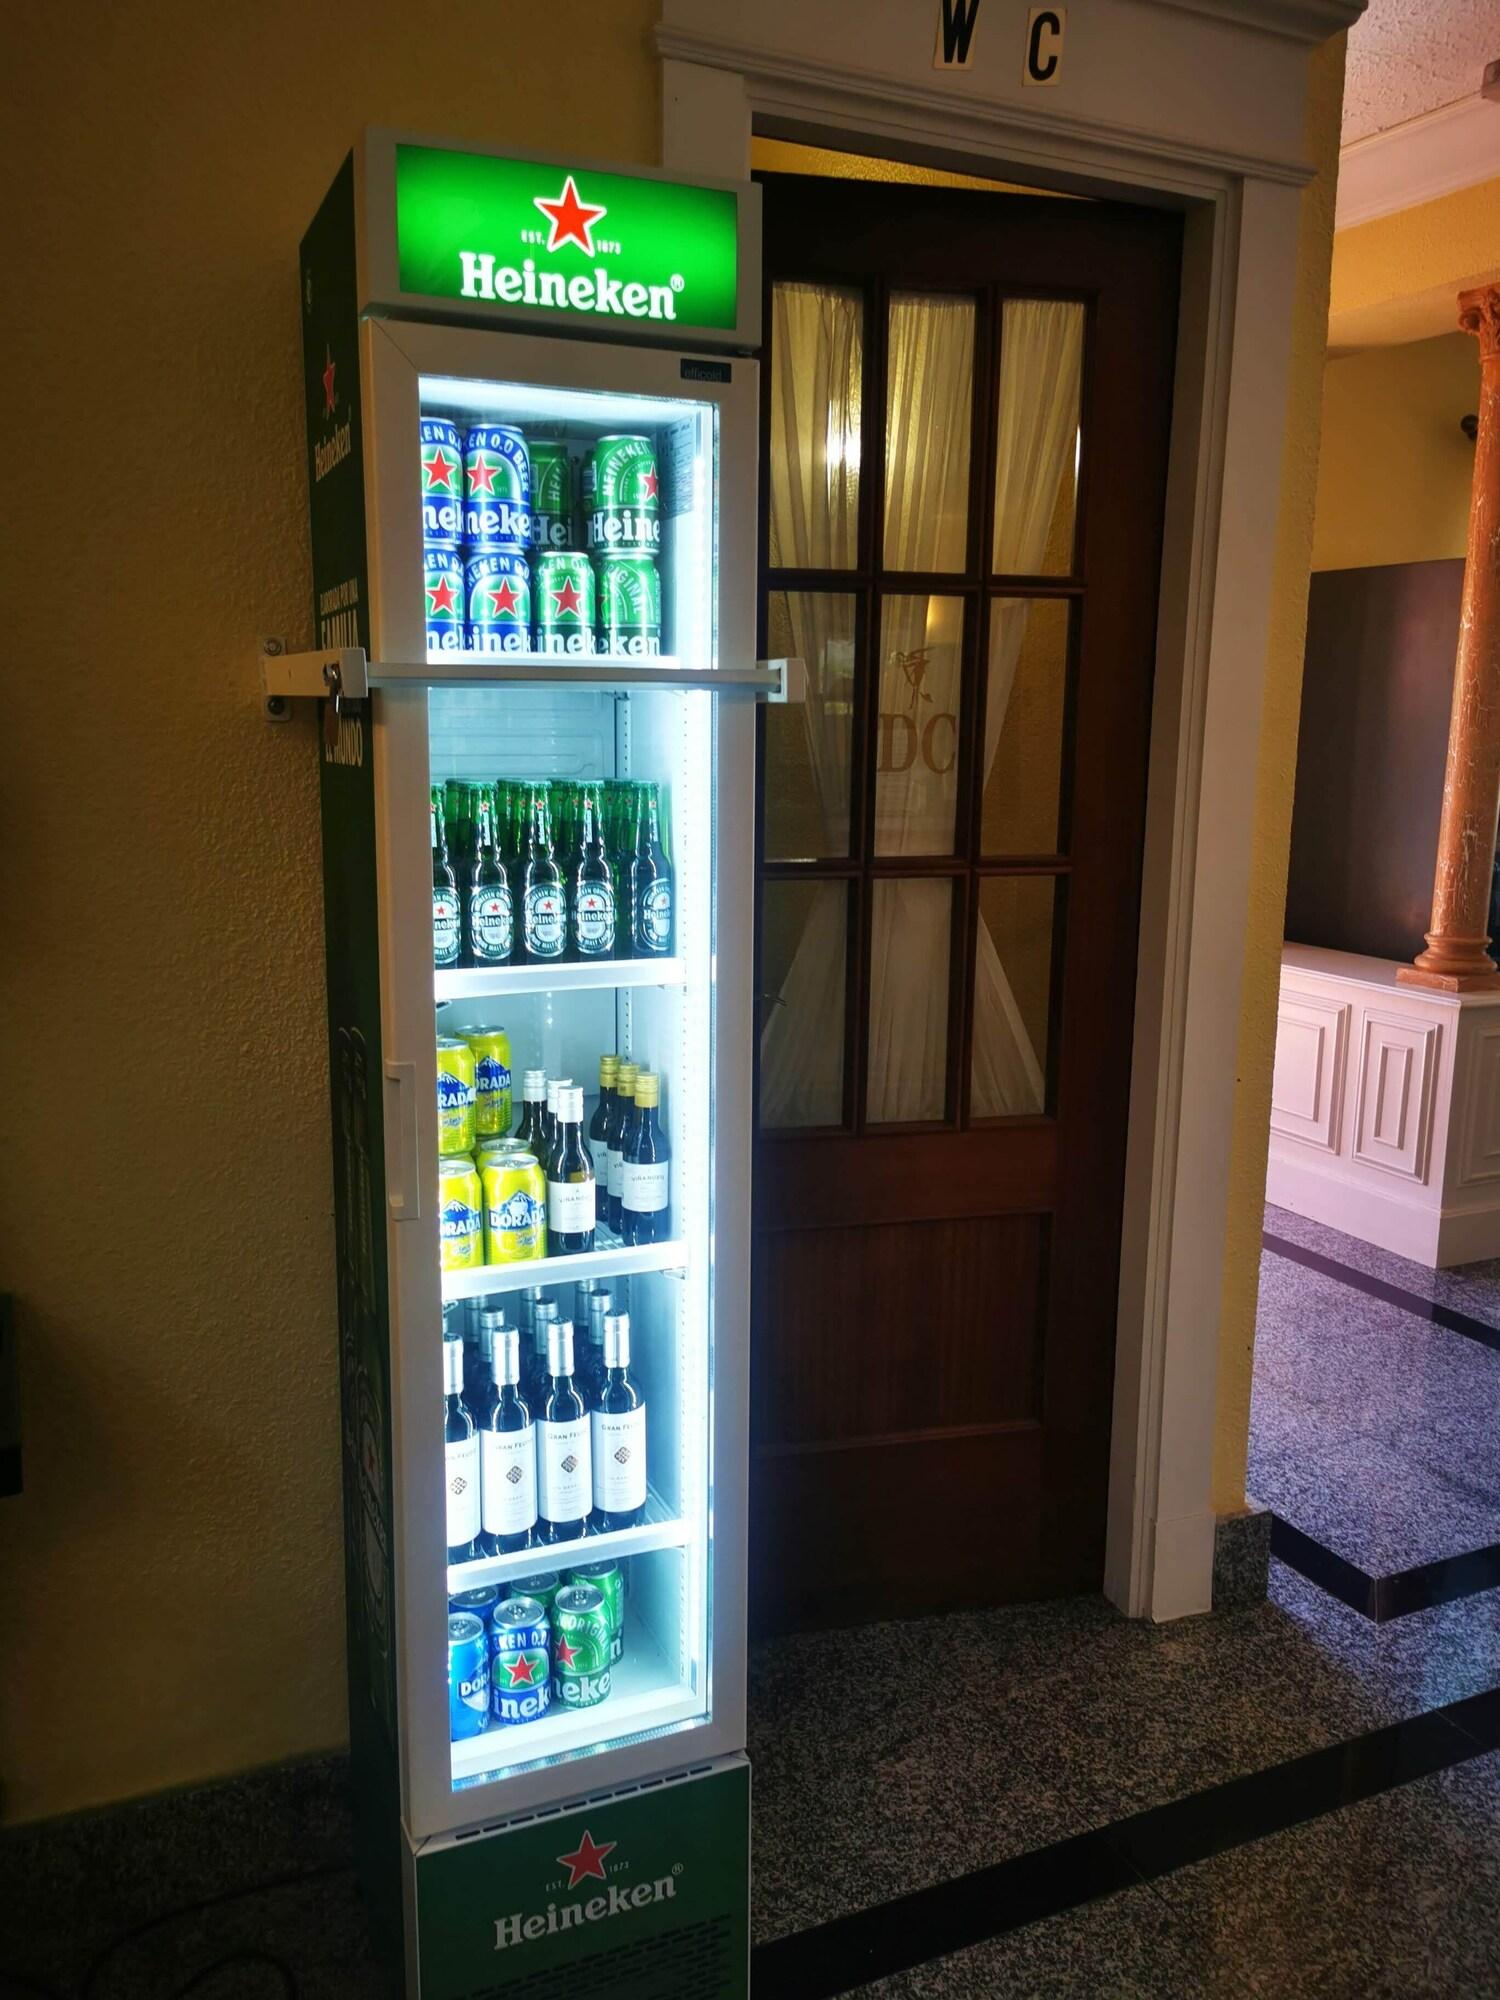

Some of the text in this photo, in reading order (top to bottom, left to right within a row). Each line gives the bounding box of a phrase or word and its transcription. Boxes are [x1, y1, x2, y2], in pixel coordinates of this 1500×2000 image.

[942, 0, 1061, 81] W C
[521, 229, 545, 245] EST.
[491, 434, 513, 453] 0.0
[877, 713, 957, 774] DC
[489, 1205, 545, 1229] DORADA
[609, 1861, 630, 1873] 1873
